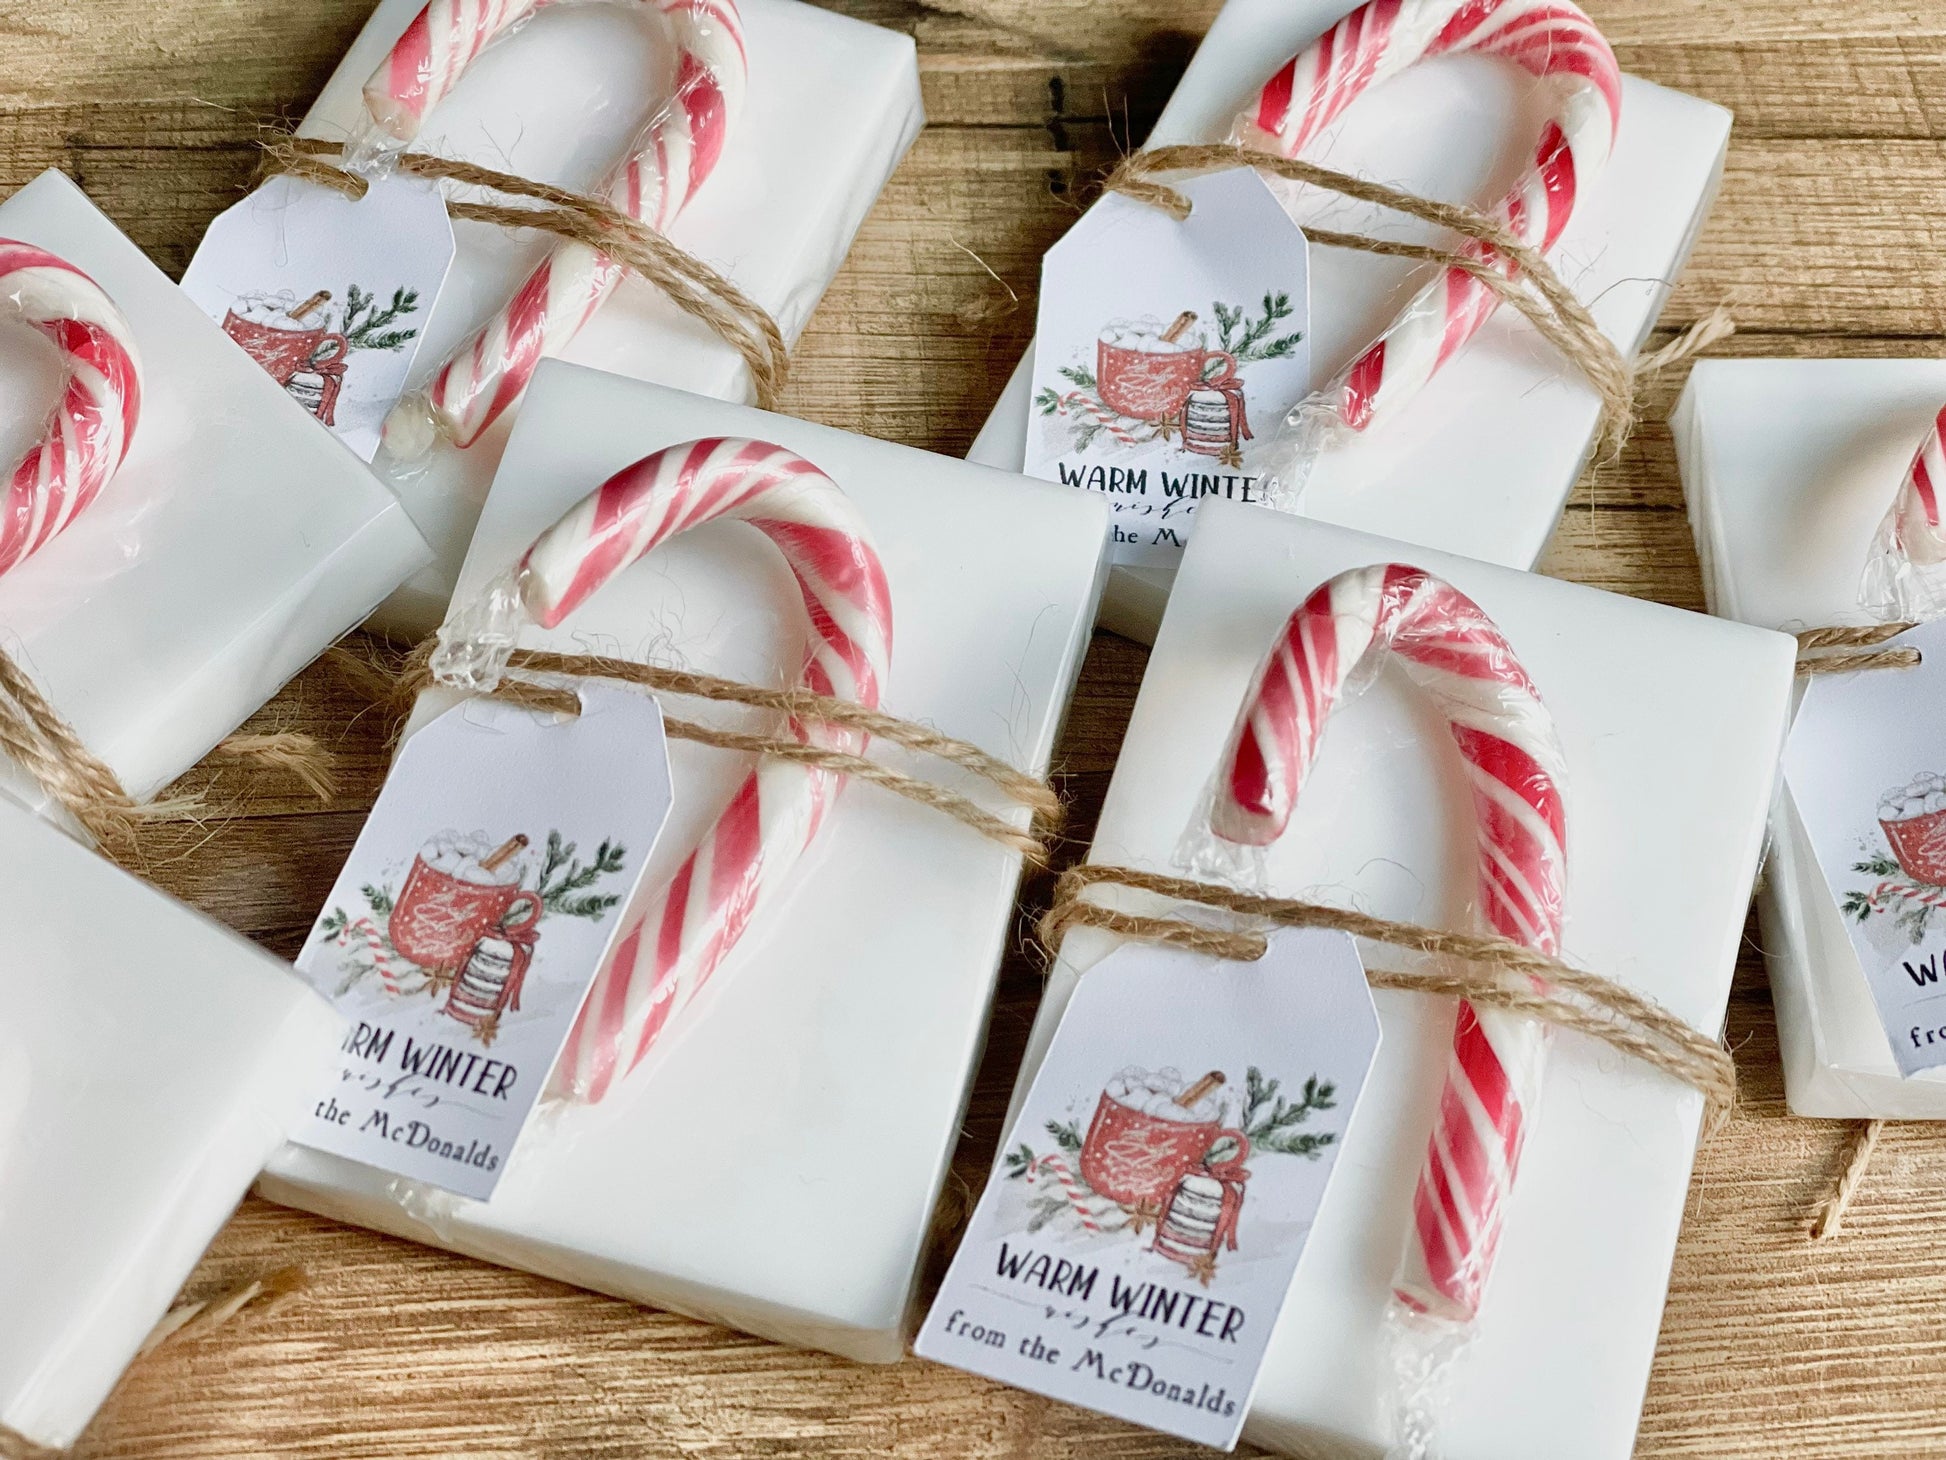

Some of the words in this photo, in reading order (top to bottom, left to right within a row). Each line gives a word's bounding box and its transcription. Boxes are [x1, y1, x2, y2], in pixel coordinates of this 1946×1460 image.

[1058, 461, 1147, 495] WARM
[1161, 471, 1265, 504] WINTE
[1113, 494, 1196, 520] wishe
[1112, 524, 1138, 544] he
[341, 1021, 395, 1064] RM
[400, 1037, 518, 1101] WINTER
[315, 1097, 352, 1126] the
[359, 1108, 500, 1173] McDonalds
[995, 1242, 1100, 1301] WARM
[1110, 1274, 1246, 1344] WINTER
[944, 1309, 1007, 1350] from
[1018, 1334, 1061, 1365] the
[1072, 1346, 1238, 1418] McDonalds
